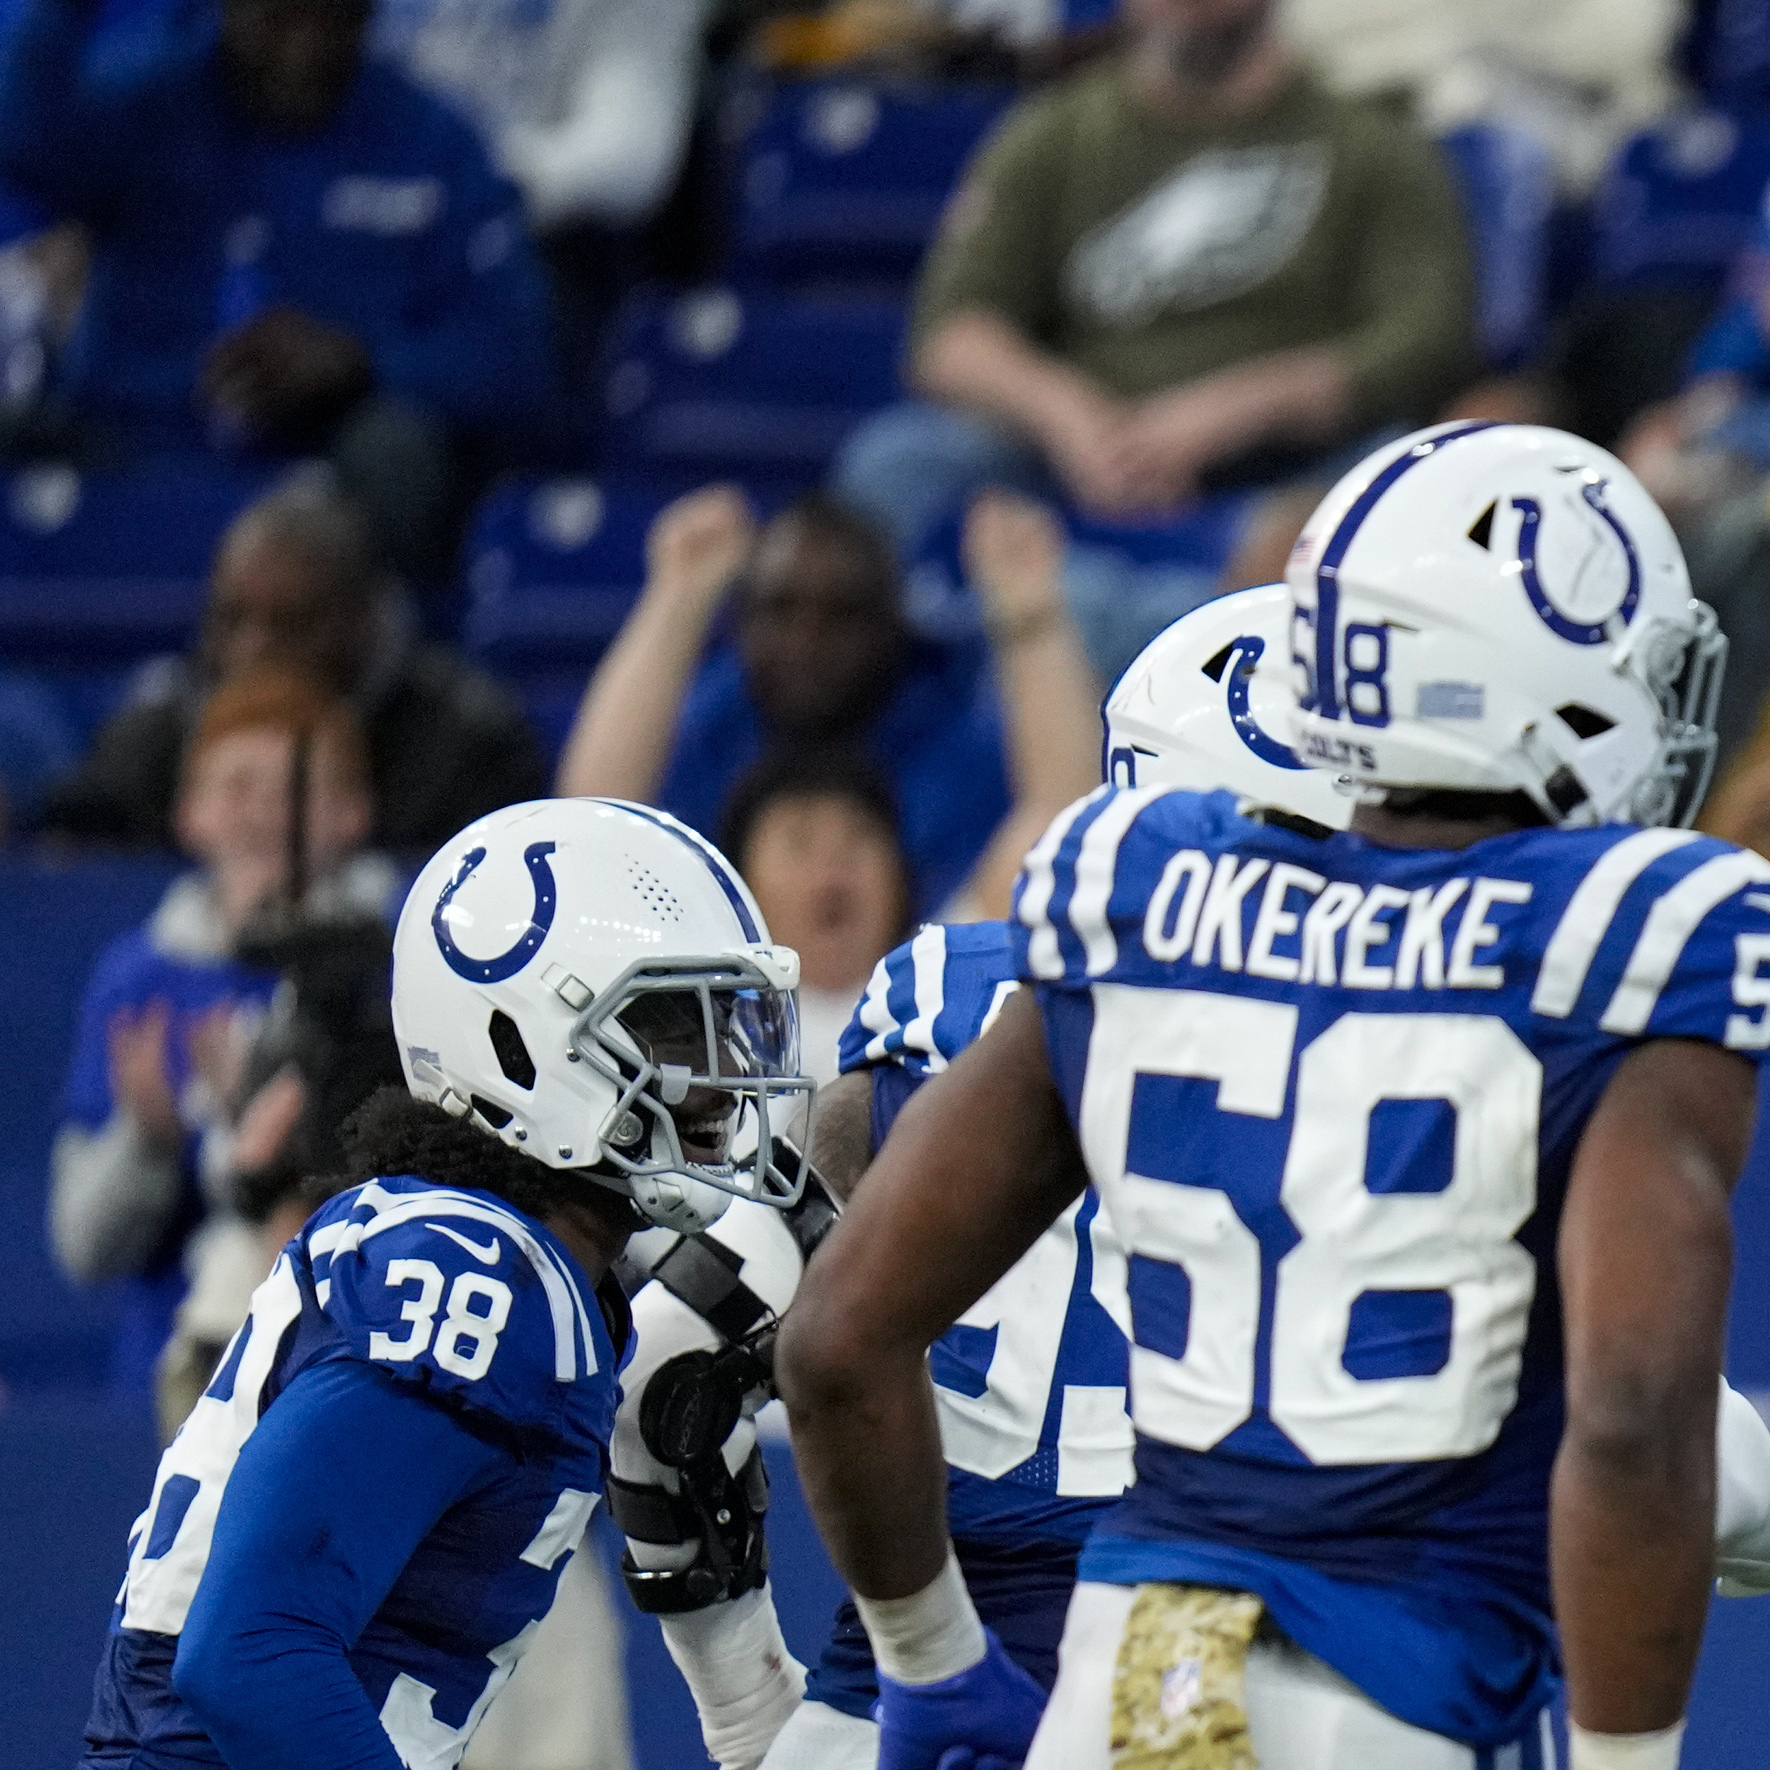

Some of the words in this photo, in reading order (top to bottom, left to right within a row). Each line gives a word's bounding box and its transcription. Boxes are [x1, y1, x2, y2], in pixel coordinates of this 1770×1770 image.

[1143, 849, 1534, 990] OKEREKE
[1079, 983, 1544, 1466] 58
[369, 1259, 513, 1381] 38
